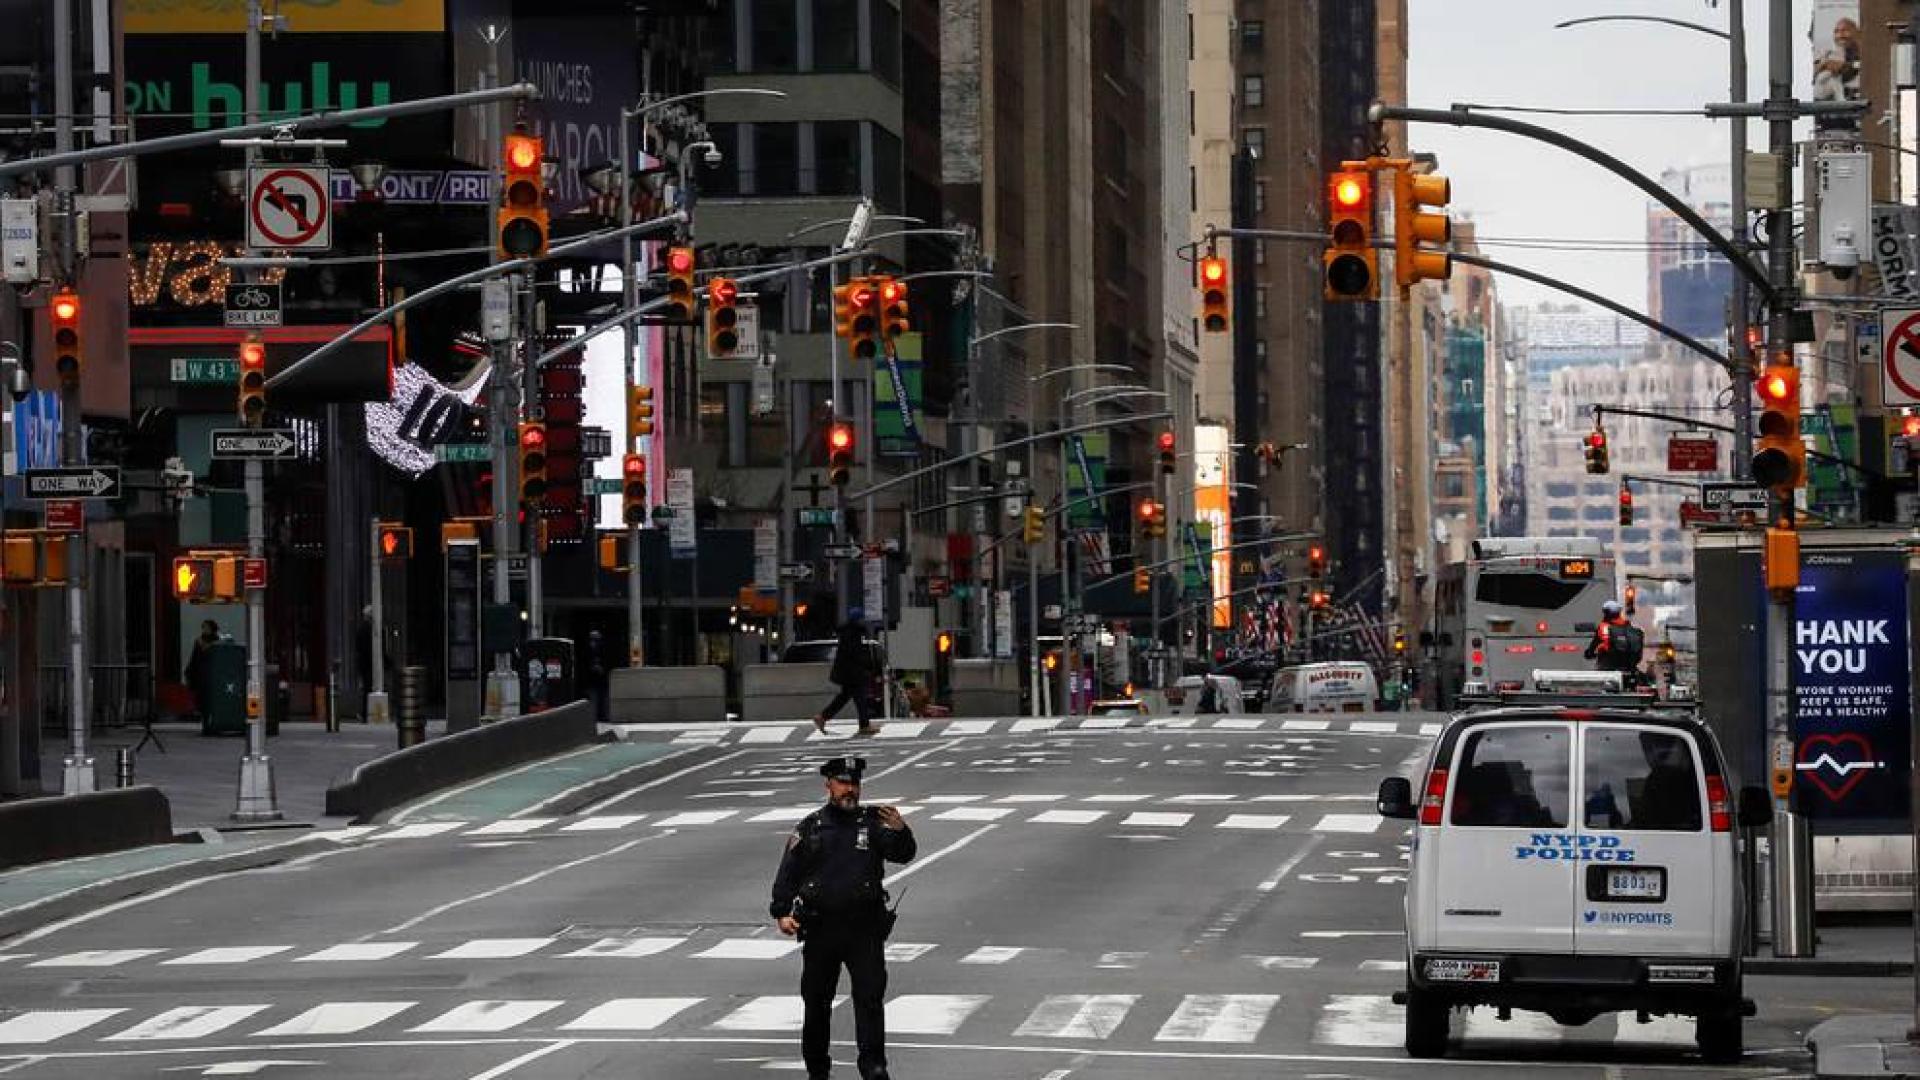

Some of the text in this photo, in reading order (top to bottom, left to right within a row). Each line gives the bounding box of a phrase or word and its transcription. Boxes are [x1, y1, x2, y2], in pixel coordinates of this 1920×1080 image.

[192, 62, 391, 128] hulu
[1878, 215, 1913, 298] MORM
[227, 311, 279, 323] BIKE LANE
[190, 361, 202, 379] W
[208, 361, 225, 379] 43
[219, 438, 284, 450] ONE WAY
[38, 477, 106, 490] ONE WAY
[1796, 620, 1890, 644] HANK
[1797, 649, 1867, 673] YOU
[1795, 686, 1893, 695] RYONE WORKING
[1801, 697, 1886, 706] KEEP US SAFE,
[1797, 707, 1821, 716] EAN
[1838, 707, 1888, 716] HEALTHY
[1530, 834, 1621, 848] NYPD
[1516, 847, 1636, 861] POLICE
[1600, 911, 1673, 925] @NYPDMTS
